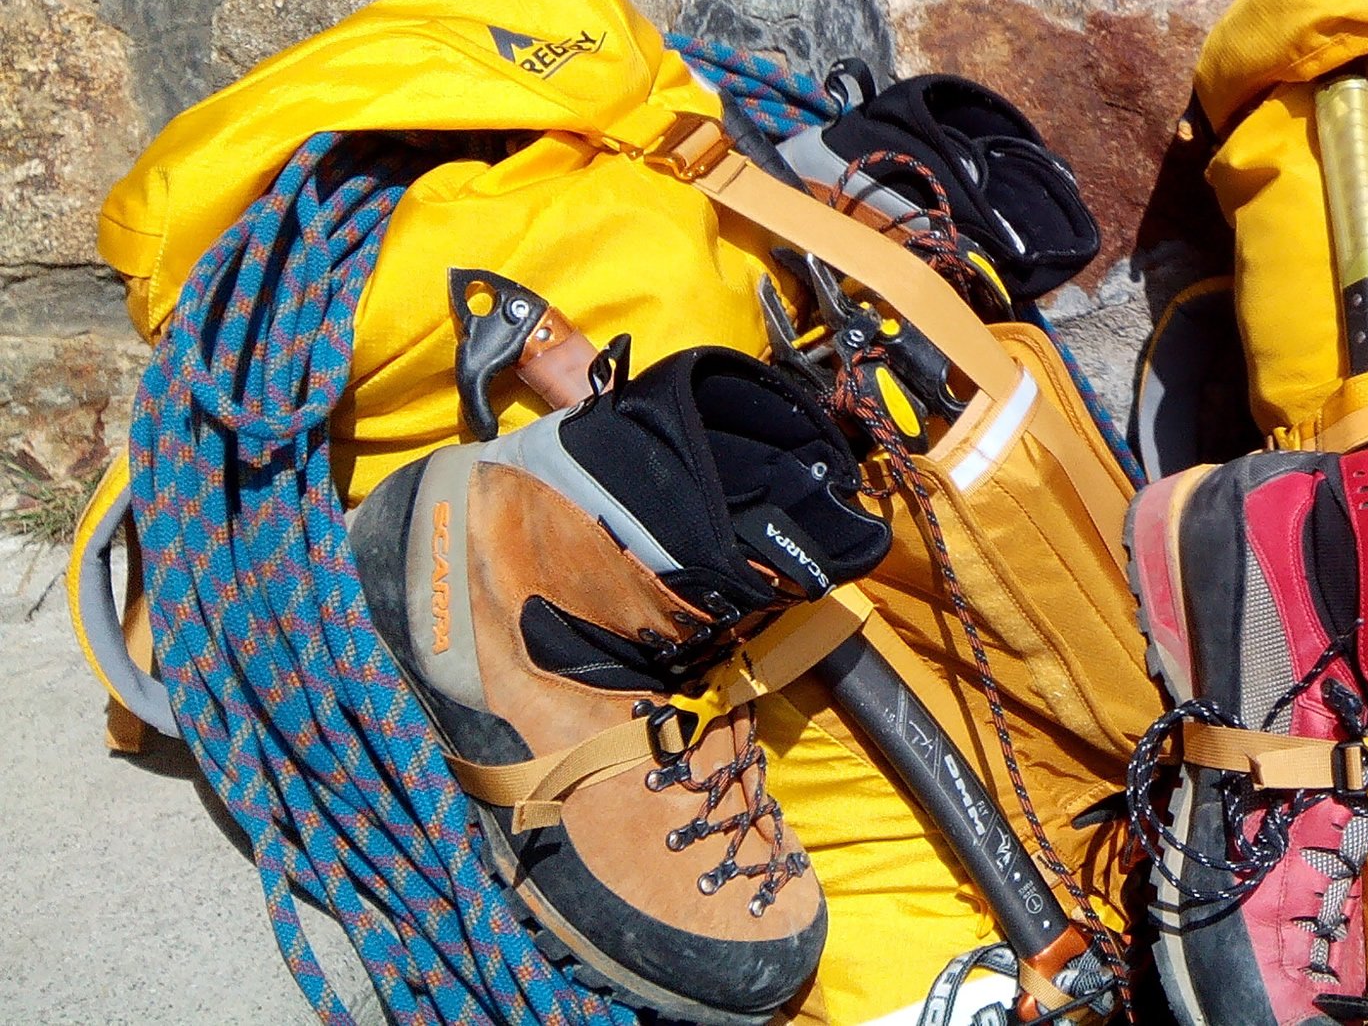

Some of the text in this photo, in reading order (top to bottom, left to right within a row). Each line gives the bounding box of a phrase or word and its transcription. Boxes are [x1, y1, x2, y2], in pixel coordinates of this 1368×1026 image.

[432, 500, 450, 655] SCARPA
[766, 522, 830, 588] SCARPA
[943, 754, 986, 836] DMM
[975, 800, 989, 817] FLY
